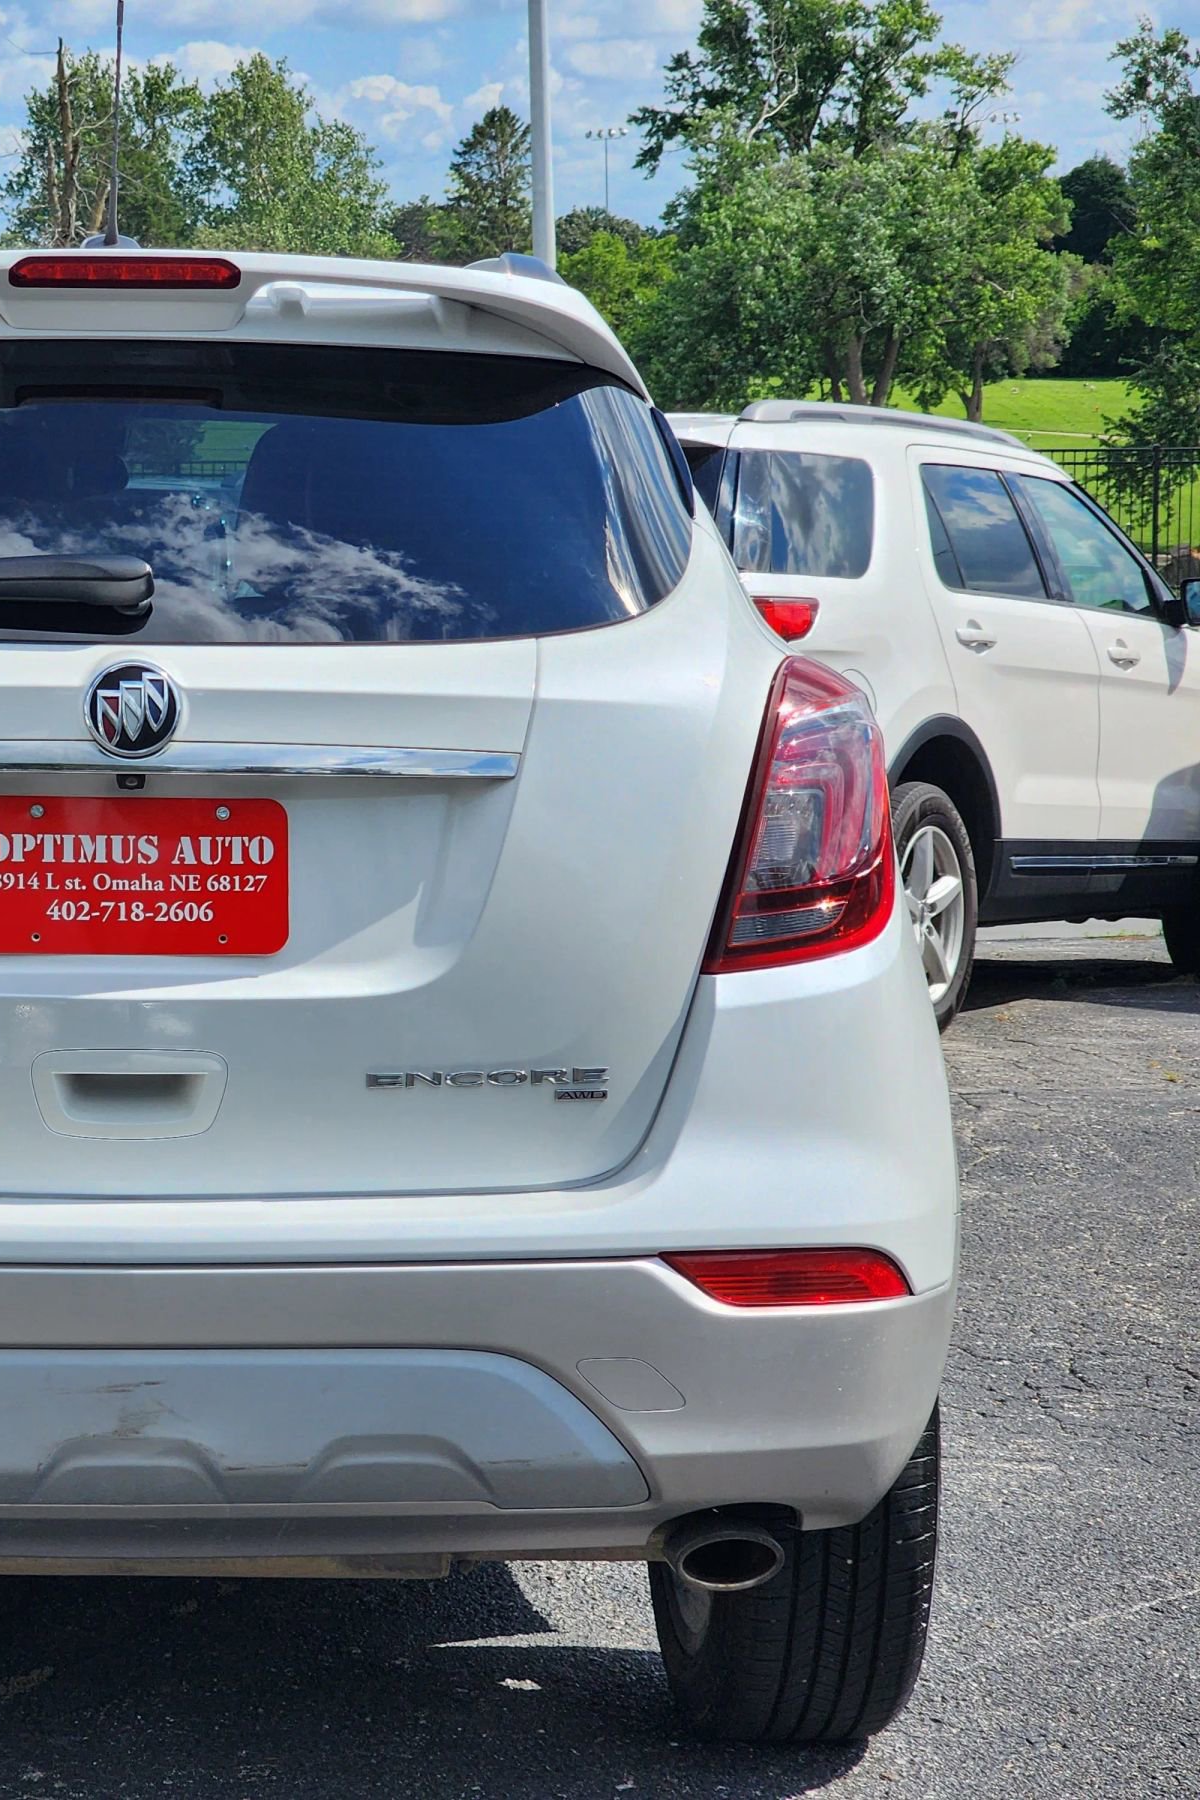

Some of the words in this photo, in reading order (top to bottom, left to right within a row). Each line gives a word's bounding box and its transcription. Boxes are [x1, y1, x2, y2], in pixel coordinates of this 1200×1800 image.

[171, 835, 274, 865] AUTO
[45, 872, 60, 890] L
[64, 876, 87, 890] st.
[92, 873, 165, 891] Omaha
[169, 874, 202, 892] NE
[206, 874, 268, 893] 68127
[46, 899, 214, 923] 402-718-2606
[366, 1067, 610, 1089] ENCORE
[556, 1089, 608, 1100] AWD
